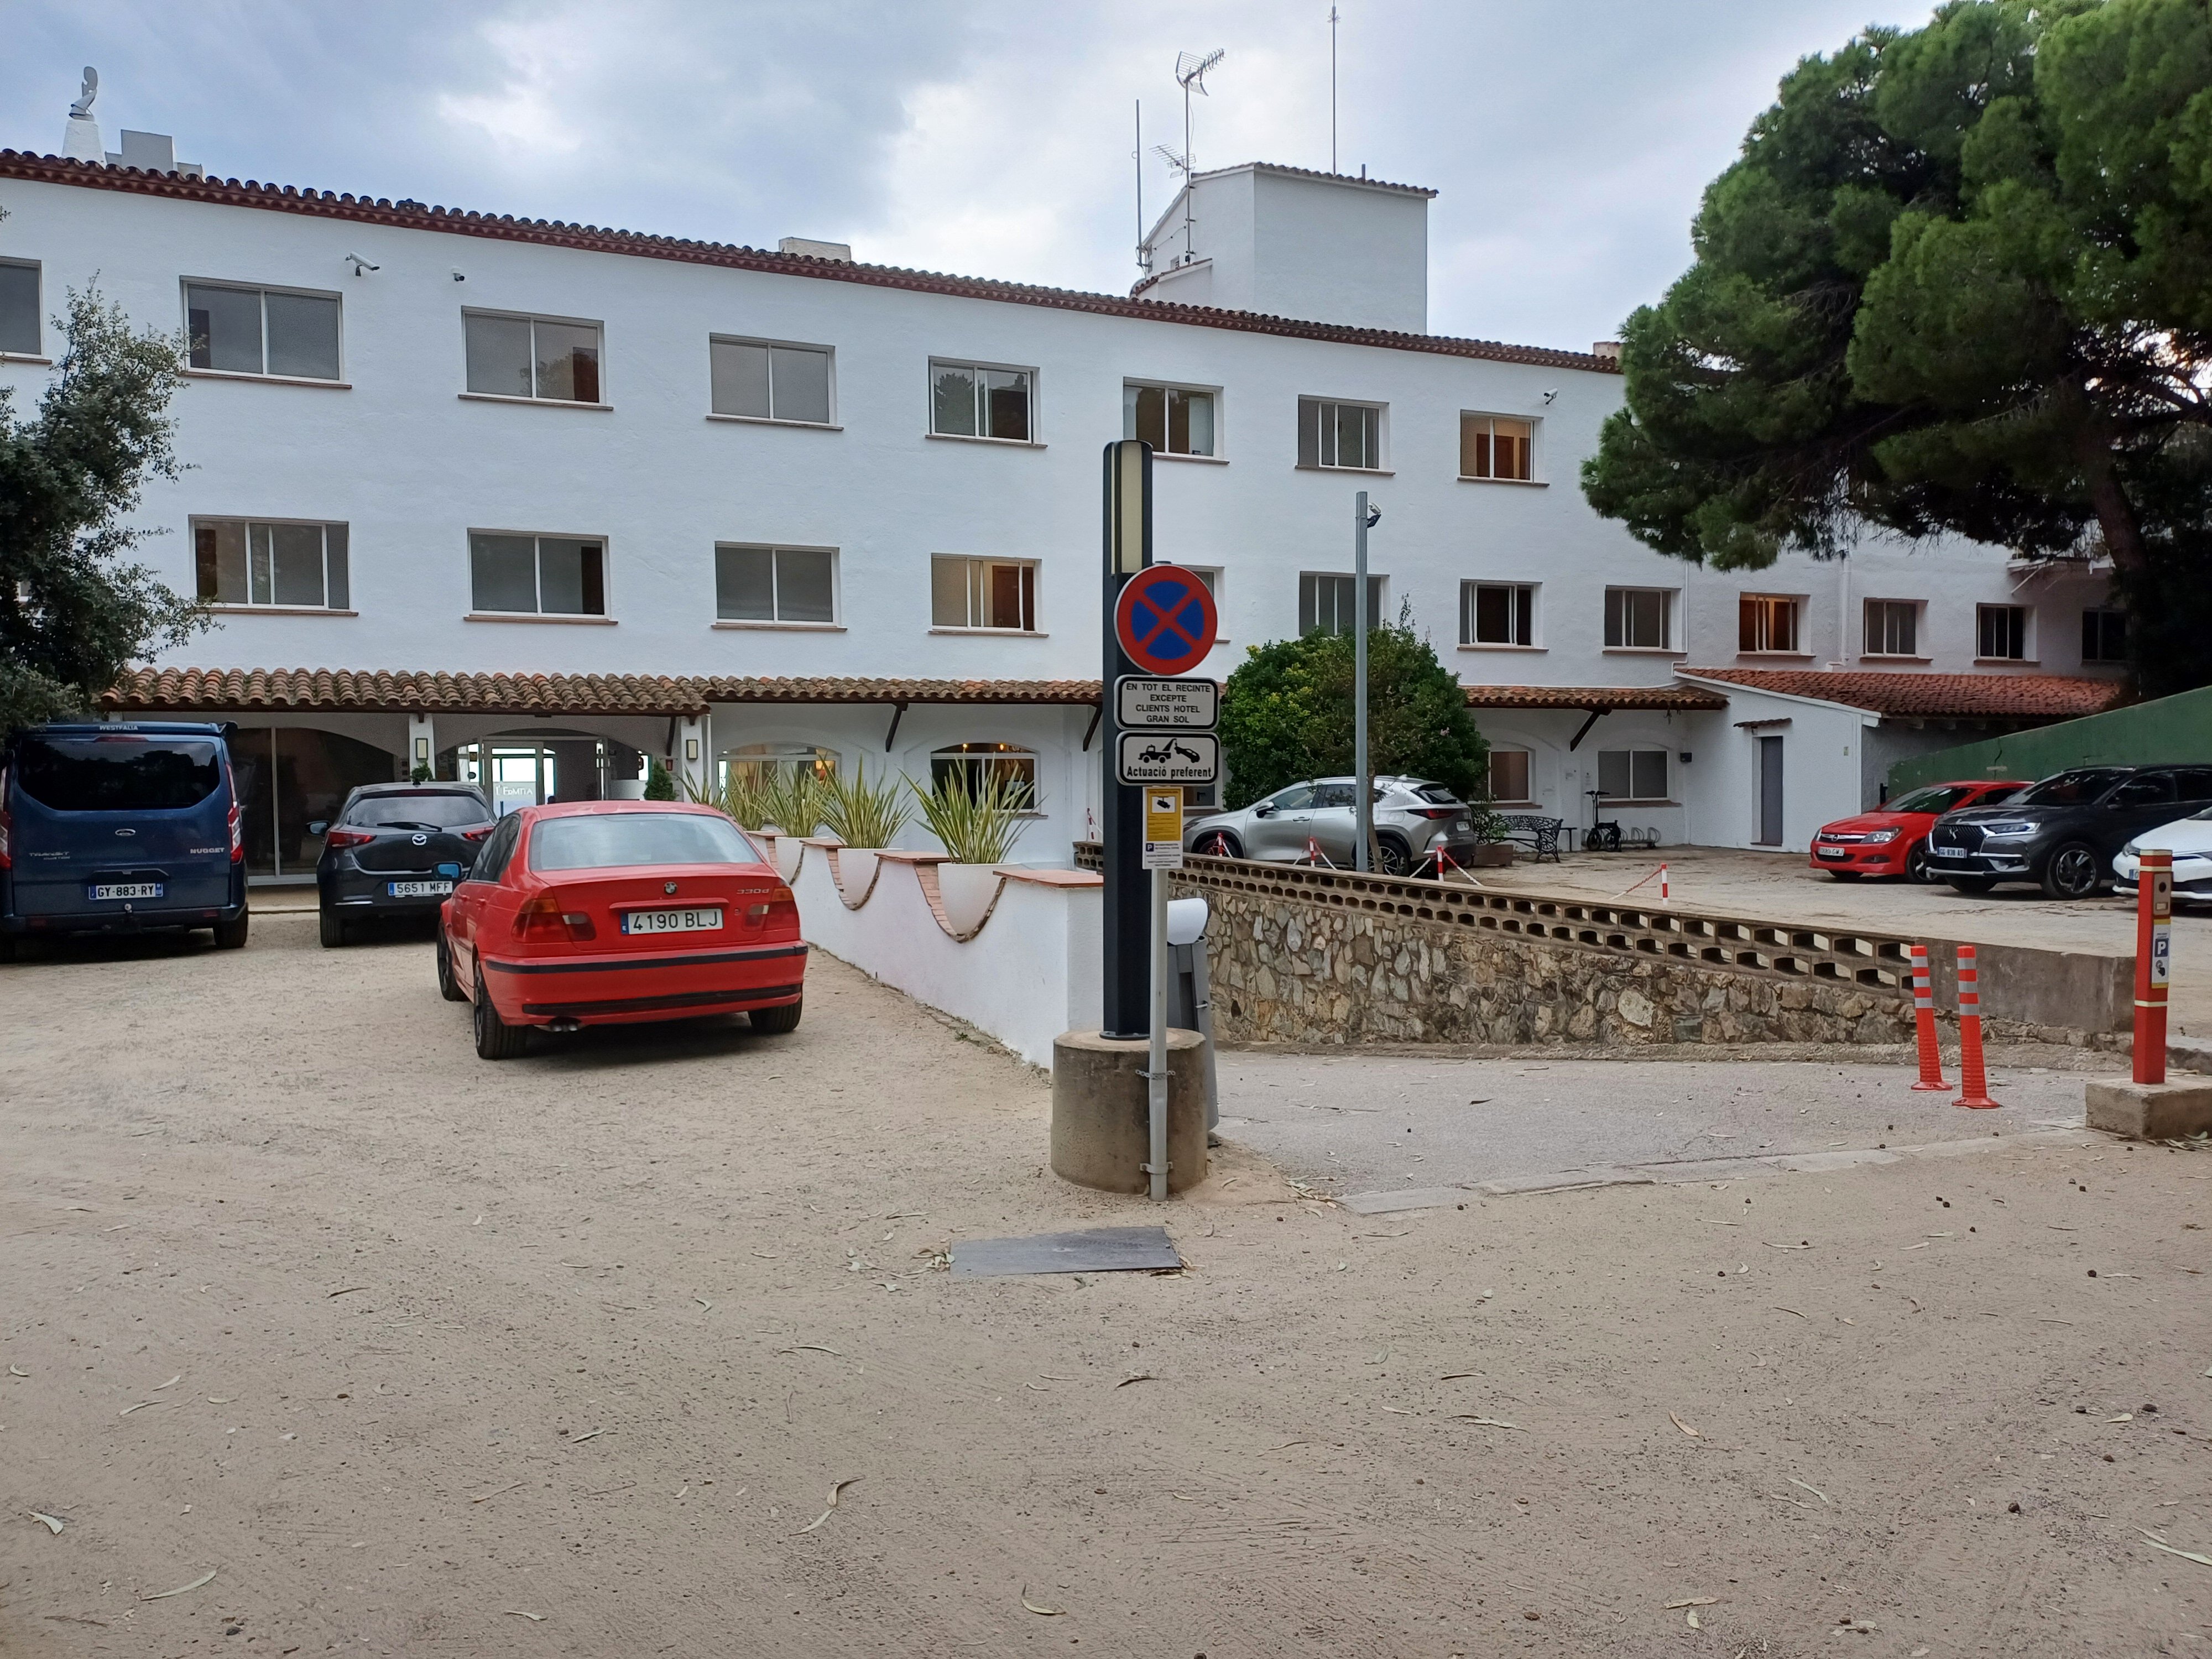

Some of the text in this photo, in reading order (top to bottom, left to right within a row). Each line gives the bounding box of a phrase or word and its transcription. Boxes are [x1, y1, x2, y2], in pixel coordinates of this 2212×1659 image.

[1150, 694, 1187, 702] EXCEPTE
[1135, 704, 1170, 712] CLIENTS
[1126, 765, 1212, 780] Actuació preferent
[397, 882, 450, 893] 5651 MFF
[633, 911, 718, 931] 4190 BLJ
[2157, 941, 2166, 955] P
